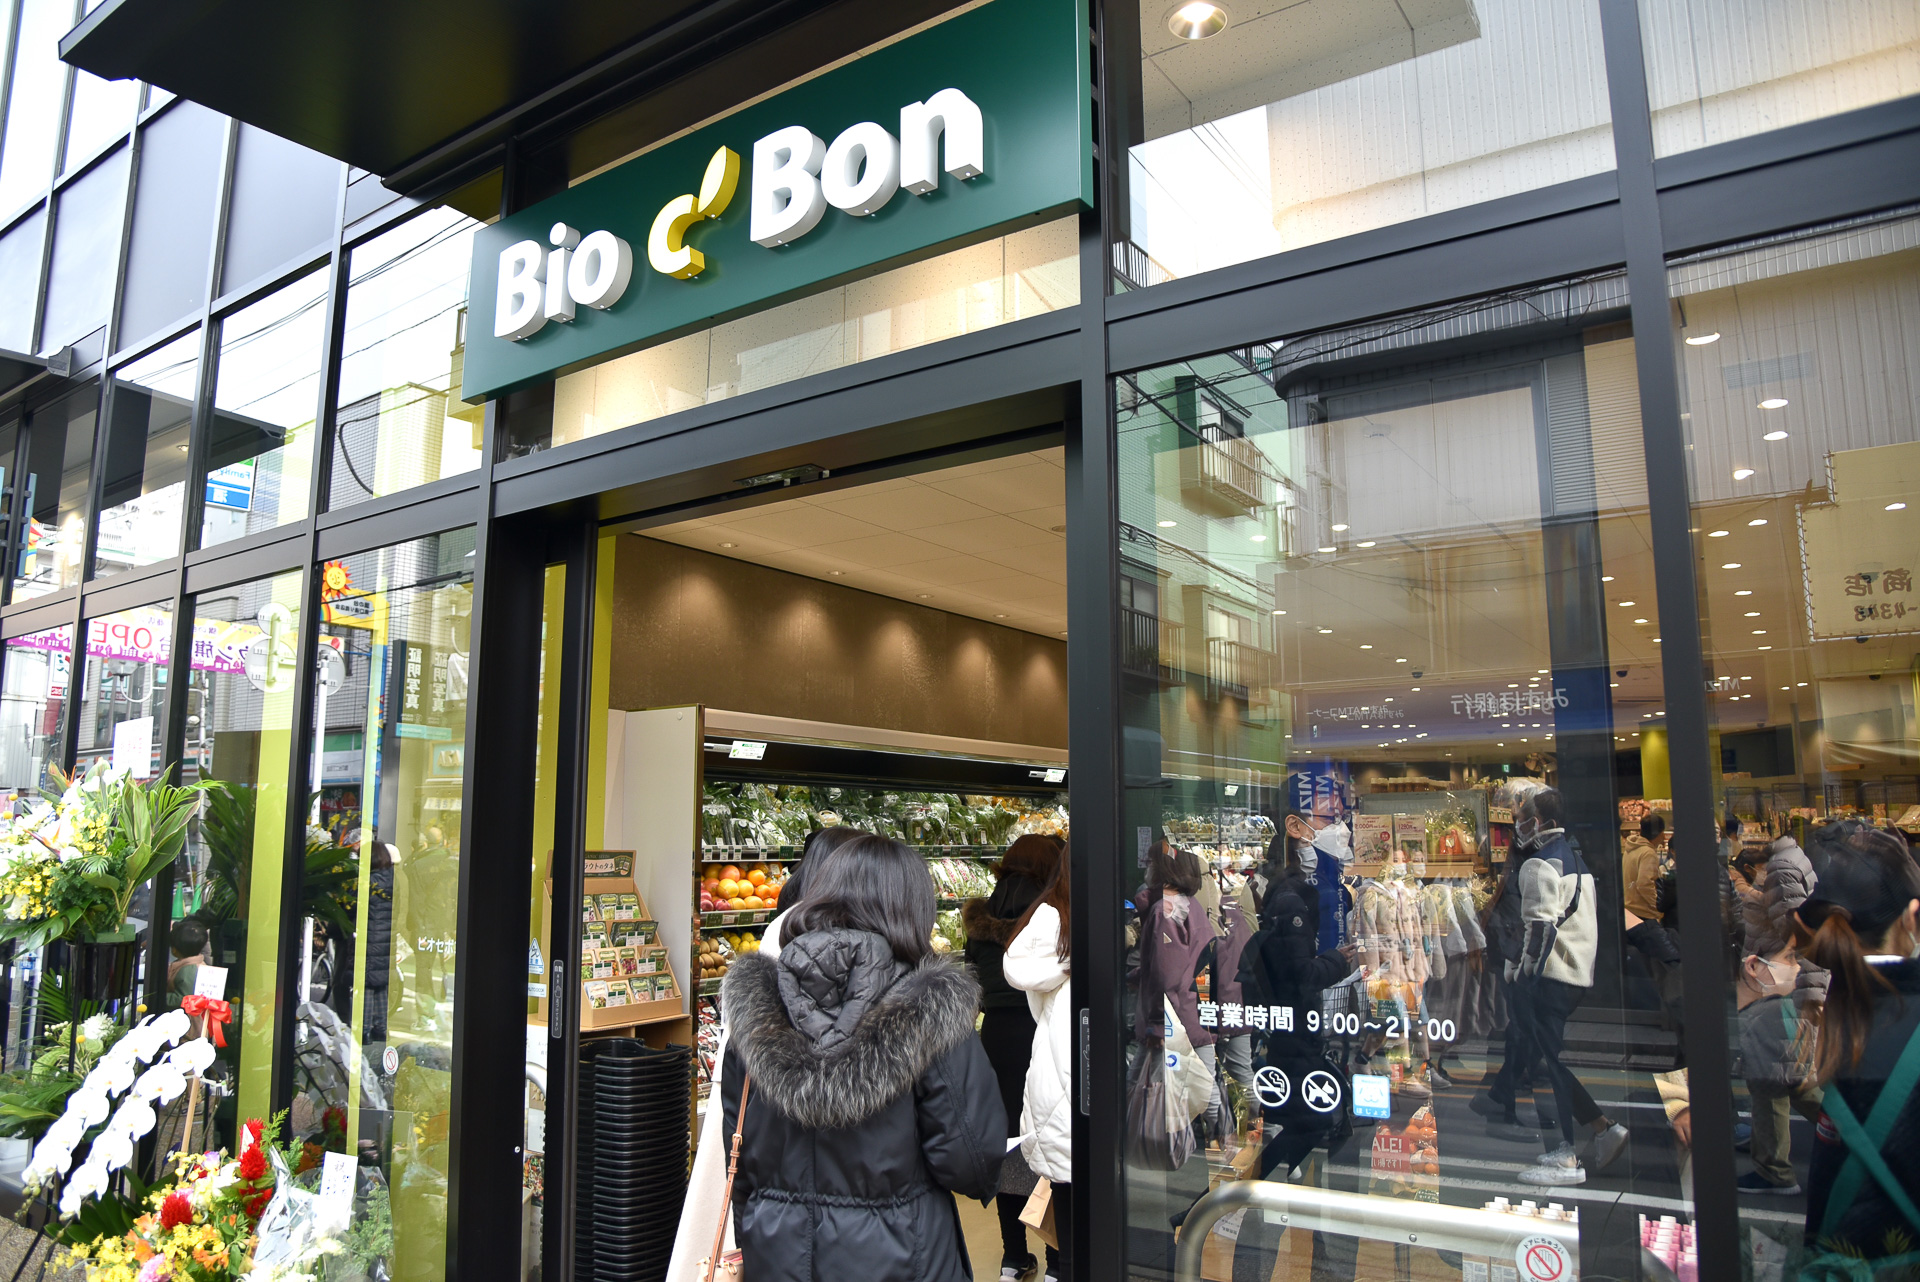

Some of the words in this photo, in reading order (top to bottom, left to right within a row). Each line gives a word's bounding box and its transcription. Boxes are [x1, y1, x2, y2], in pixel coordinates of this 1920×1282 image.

[494, 222, 632, 342] Bio
[750, 87, 984, 249] Bon
[418, 936, 457, 955] ビオセボ
[1197, 1001, 1294, 1032] 営業時間
[1356, 1108, 1388, 1117] ほじょ犬
[1371, 1136, 1403, 1153] ALE!
